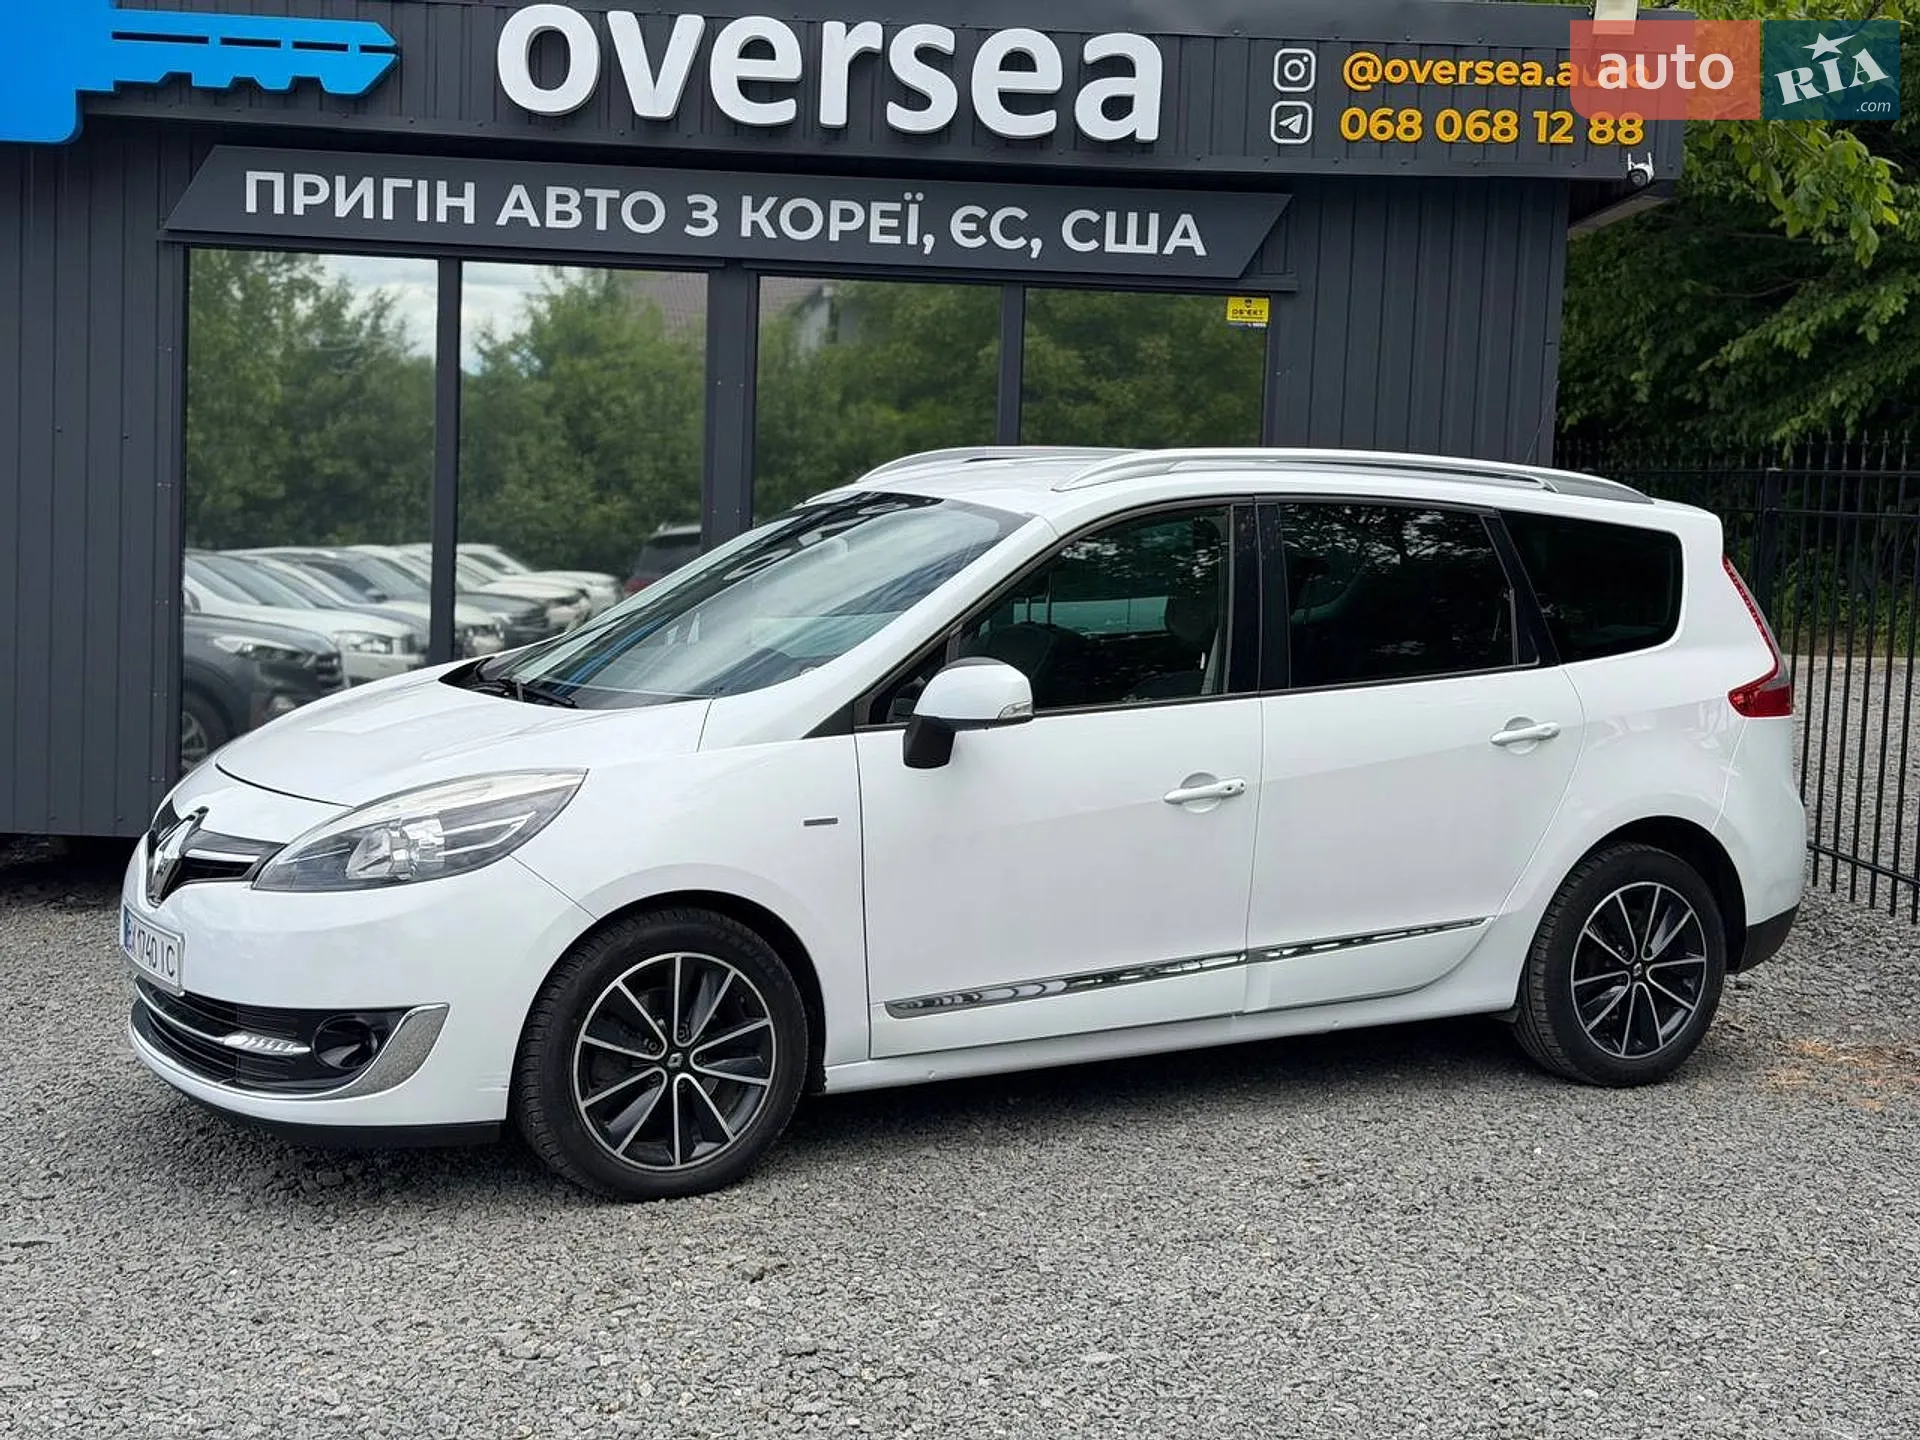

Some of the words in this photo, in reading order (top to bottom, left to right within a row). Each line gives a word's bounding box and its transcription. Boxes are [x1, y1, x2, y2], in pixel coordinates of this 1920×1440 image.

[497, 3, 1163, 143] oversea
[1339, 107, 1424, 143] 068
[1434, 108, 1520, 144] 068
[1532, 109, 1575, 145] 12
[1587, 110, 1645, 146] 88
[245, 170, 476, 226] ПРИГІН
[495, 184, 666, 235] АВТО
[740, 191, 936, 256] КОРЕЇ,
[949, 205, 1043, 259] ЄС,
[1061, 209, 1208, 257] США
